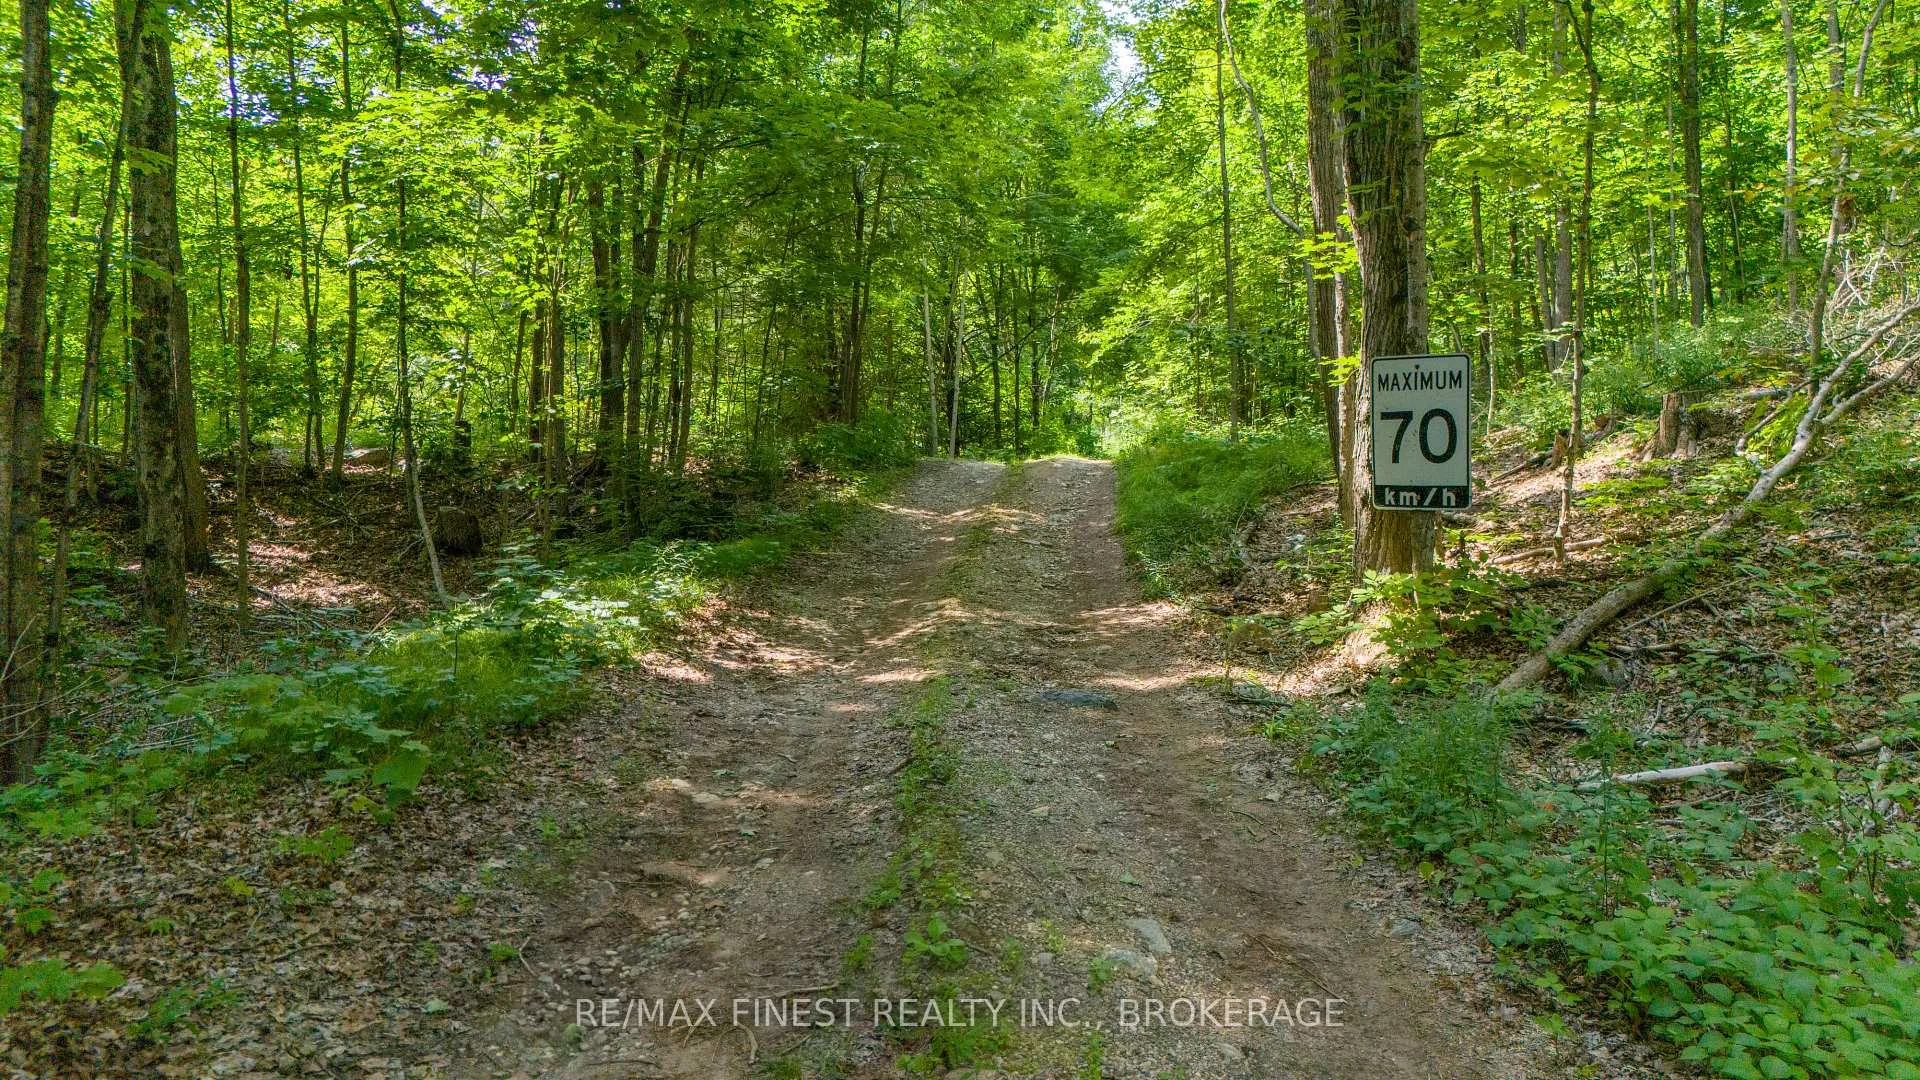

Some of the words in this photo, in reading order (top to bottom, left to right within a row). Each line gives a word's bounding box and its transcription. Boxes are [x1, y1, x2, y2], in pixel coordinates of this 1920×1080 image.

[1378, 370, 1462, 392] MAXIMUM
[1380, 408, 1457, 464] 70
[1384, 487, 1456, 506] km/h
